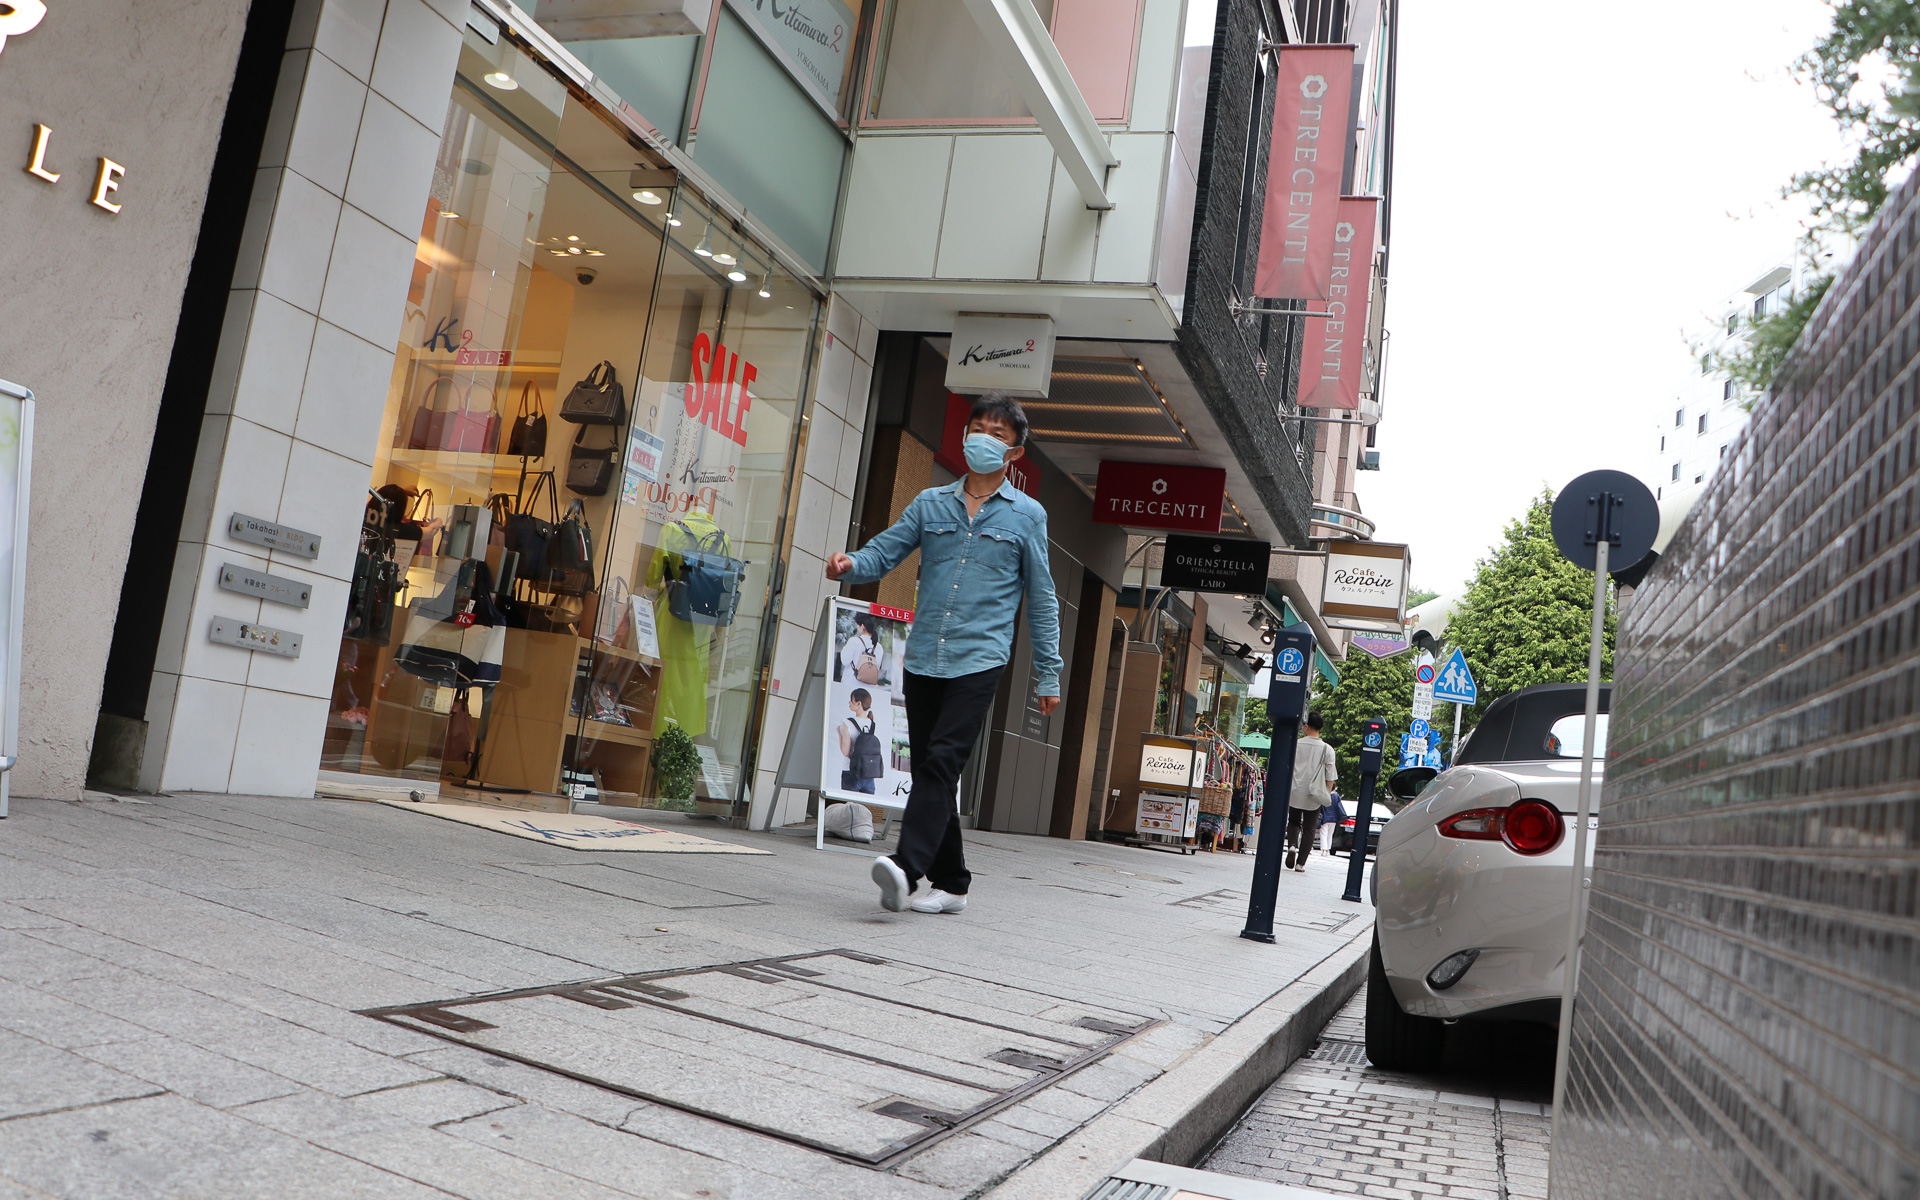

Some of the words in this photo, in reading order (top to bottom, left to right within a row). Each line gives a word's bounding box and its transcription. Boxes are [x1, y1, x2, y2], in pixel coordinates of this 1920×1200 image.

[797, 47, 829, 91] YOKOHAMA
[1283, 104, 1323, 265] TRECENTI
[1321, 247, 1352, 382] TRECENTI
[462, 352, 505, 365] SALE
[685, 332, 758, 447] SALE
[634, 449, 654, 467] SALE
[1109, 498, 1206, 519] TRECENTI
[1191, 567, 1215, 575] ETHICAL
[1334, 569, 1394, 588] Renoir
[1352, 567, 1375, 577] Cafe
[1200, 579, 1226, 589] LABO
[880, 607, 910, 620] SALE
[1367, 643, 1393, 652] カラカラ
[1282, 653, 1294, 671] P
[1413, 723, 1422, 736] P
[1146, 756, 1186, 771] Renoir
[1157, 755, 1174, 763] Cafe
